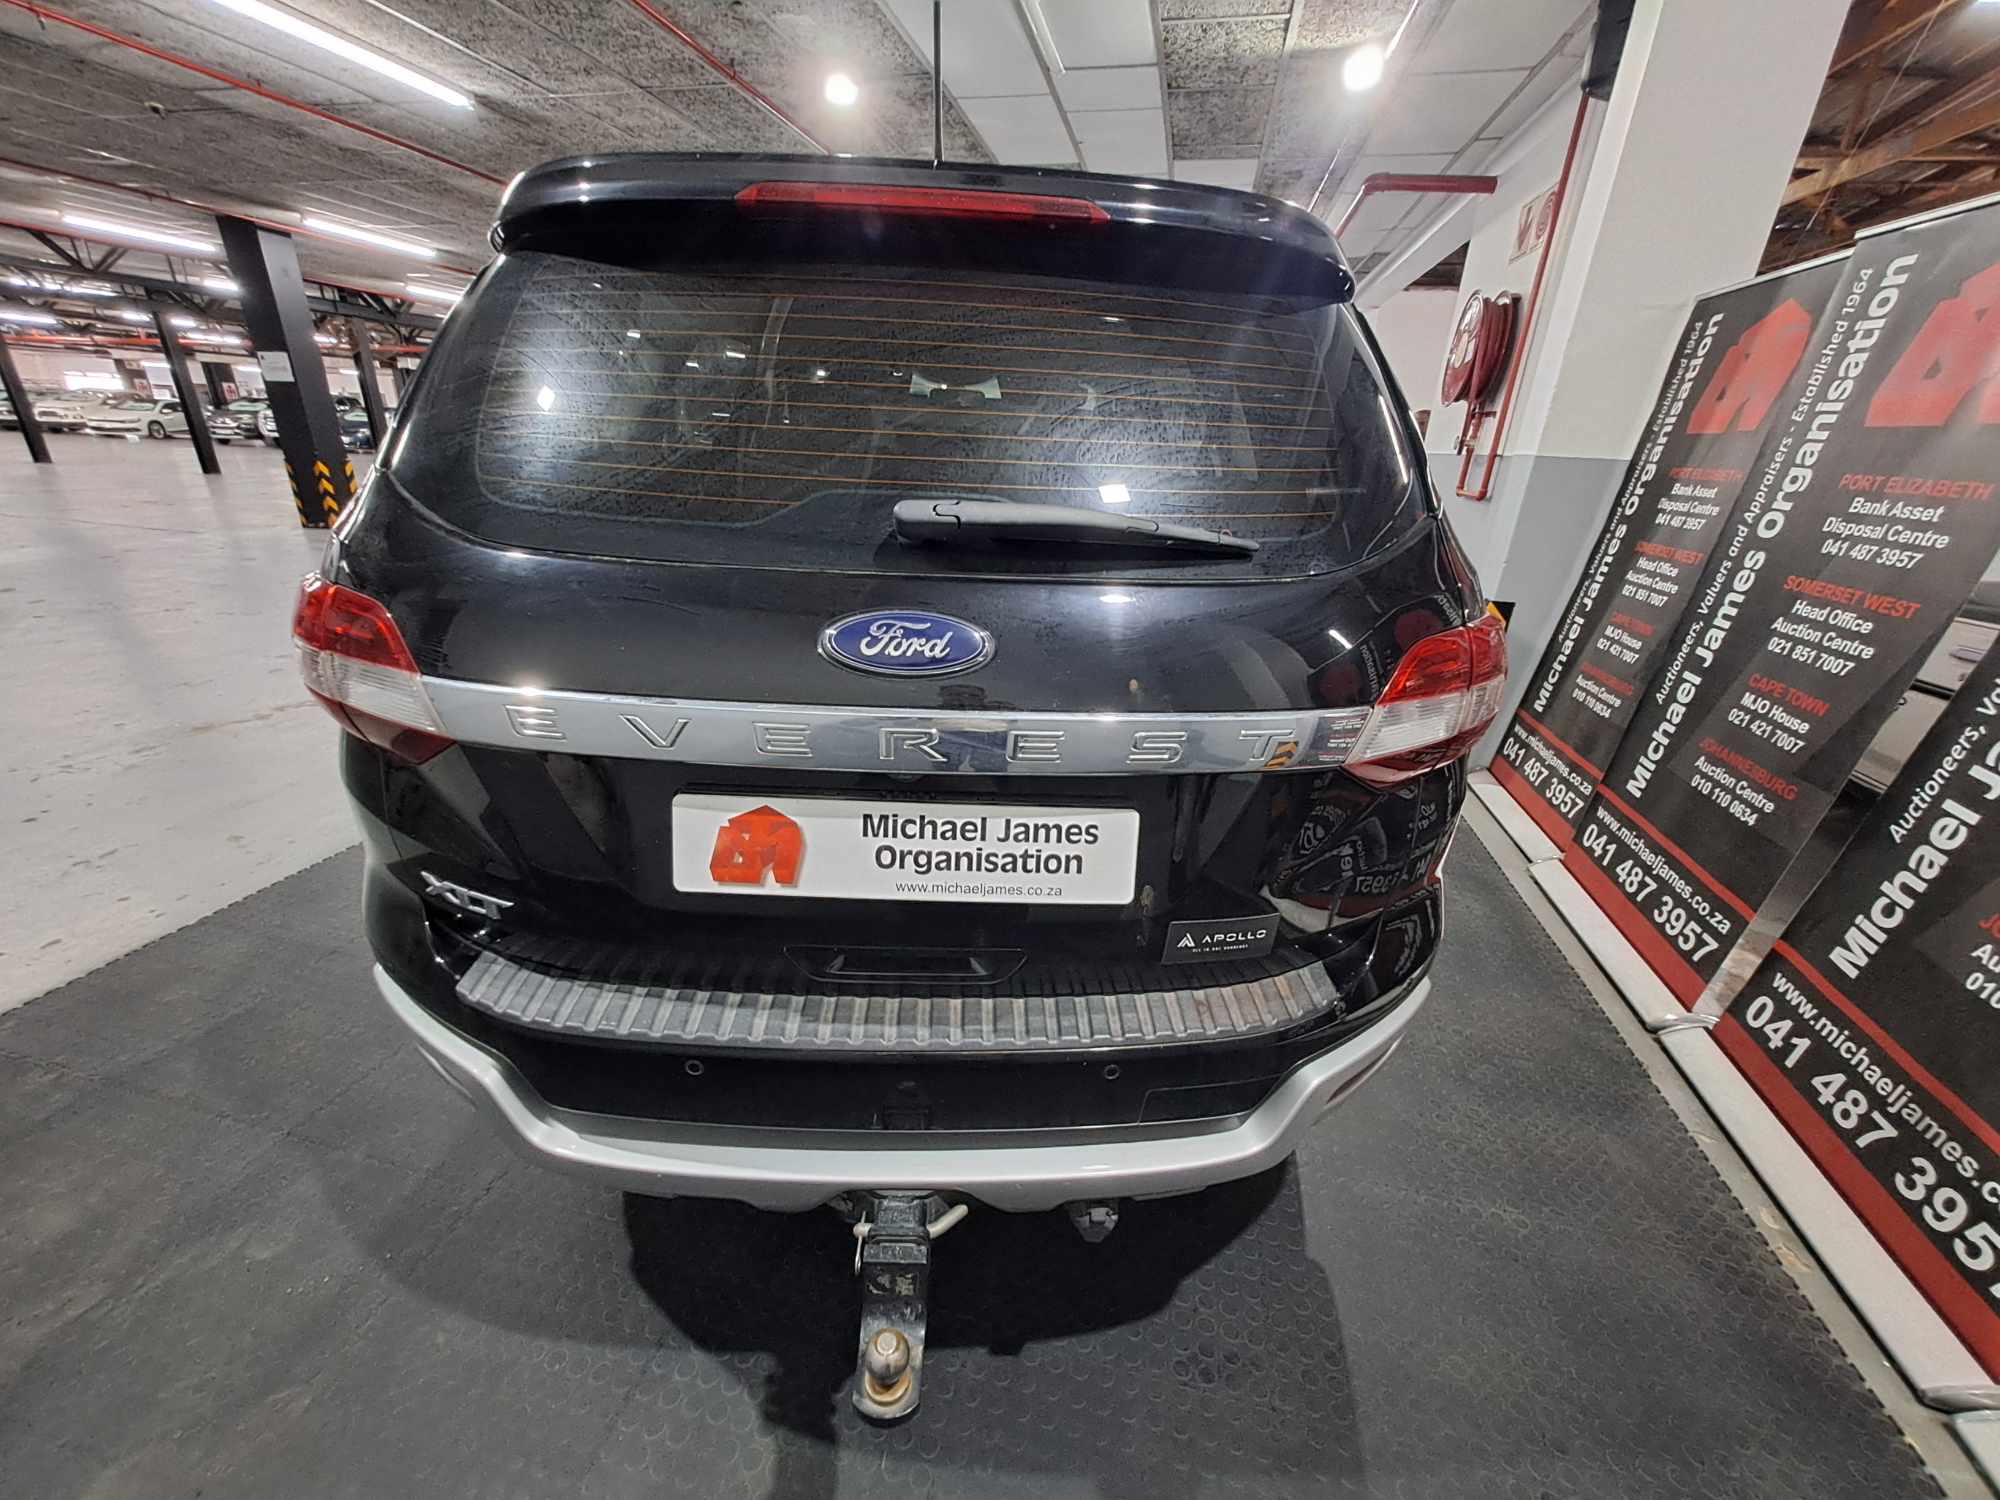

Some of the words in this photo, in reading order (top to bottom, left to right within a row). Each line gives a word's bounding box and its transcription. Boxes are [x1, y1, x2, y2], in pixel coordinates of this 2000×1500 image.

[1655, 620, 1706, 706] Auctioneers,
[1696, 558, 1733, 615] Valuers
[1727, 524, 1750, 557] and
[1743, 437, 1794, 525] Appraisers
[1791, 320, 1850, 423] Established
[1841, 267, 1875, 316] 1964
[1657, 498, 1692, 514] Disposal
[1690, 501, 1720, 517] Centre
[1671, 483, 1694, 496] Bank
[1692, 484, 1718, 499] Asset
[1838, 473, 1885, 490] PORT
[1884, 476, 1996, 501] ELIZABETH
[1533, 615, 1586, 713] Michael
[1582, 523, 1628, 612] James
[1624, 312, 1725, 516] Organisation
[1625, 670, 1703, 799] Michael
[1694, 550, 1767, 668] James
[1756, 253, 1920, 540] Organisation
[1848, 497, 1891, 517] Bank
[1887, 501, 1945, 523] Asset
[1822, 516, 1888, 541] Disposal
[1887, 525, 1951, 549] Centre
[1636, 556, 1659, 572] Head
[1656, 561, 1680, 578] Office
[1821, 539, 1850, 557] 041
[1849, 543, 1879, 562] 487
[1876, 548, 1925, 570] 3957
[1651, 577, 1680, 594] Centre
[1783, 575, 1864, 605] SOMERSET
[1863, 593, 1922, 620] WEST
[1770, 616, 1823, 643] Auction
[1822, 631, 1876, 660] Centre
[1791, 599, 1832, 622] Head
[1828, 609, 1875, 634] Office
[859, 619, 954, 660] Ford
[1767, 636, 1793, 656] 021
[1791, 645, 1818, 665] 851
[1816, 654, 1857, 677] 7007
[1598, 687, 1622, 708] Centre
[1740, 691, 1771, 714] MJO
[1768, 704, 1811, 734] House
[1749, 672, 1787, 698] CAPE
[1786, 687, 1832, 718] TOWN
[502, 703, 1298, 764] EVEREST
[1728, 708, 1752, 728] 021
[1750, 720, 1773, 739] 421
[1770, 729, 1807, 754] 7007
[1503, 737, 1526, 767] 041
[1523, 757, 1550, 788] 487
[1545, 776, 1586, 820] 3957
[1694, 755, 1738, 789] Auction
[1735, 780, 1776, 814] Centre
[1888, 724, 1987, 844] Auctioneers,
[1691, 774, 1712, 795] 010
[1711, 788, 1732, 808] 110
[1728, 800, 1760, 827] 0634
[861, 813, 989, 843] Michael
[996, 817, 1101, 846] James
[874, 843, 1084, 876] Organisation
[1596, 804, 1733, 936] www.michaeljames.co.za
[421, 871, 515, 920] XLT
[894, 879, 1064, 899] www.michaeljames.co.za
[1582, 823, 1618, 867] 041
[1615, 859, 1659, 903] 487
[1653, 895, 1720, 963] 3957
[1828, 798, 1983, 980] Michael
[1202, 929, 1268, 943] APOLLO
[1745, 995, 1812, 1069] 041
[1810, 1072, 1899, 1150] 487
[1895, 1156, 2000, 1298] 395
